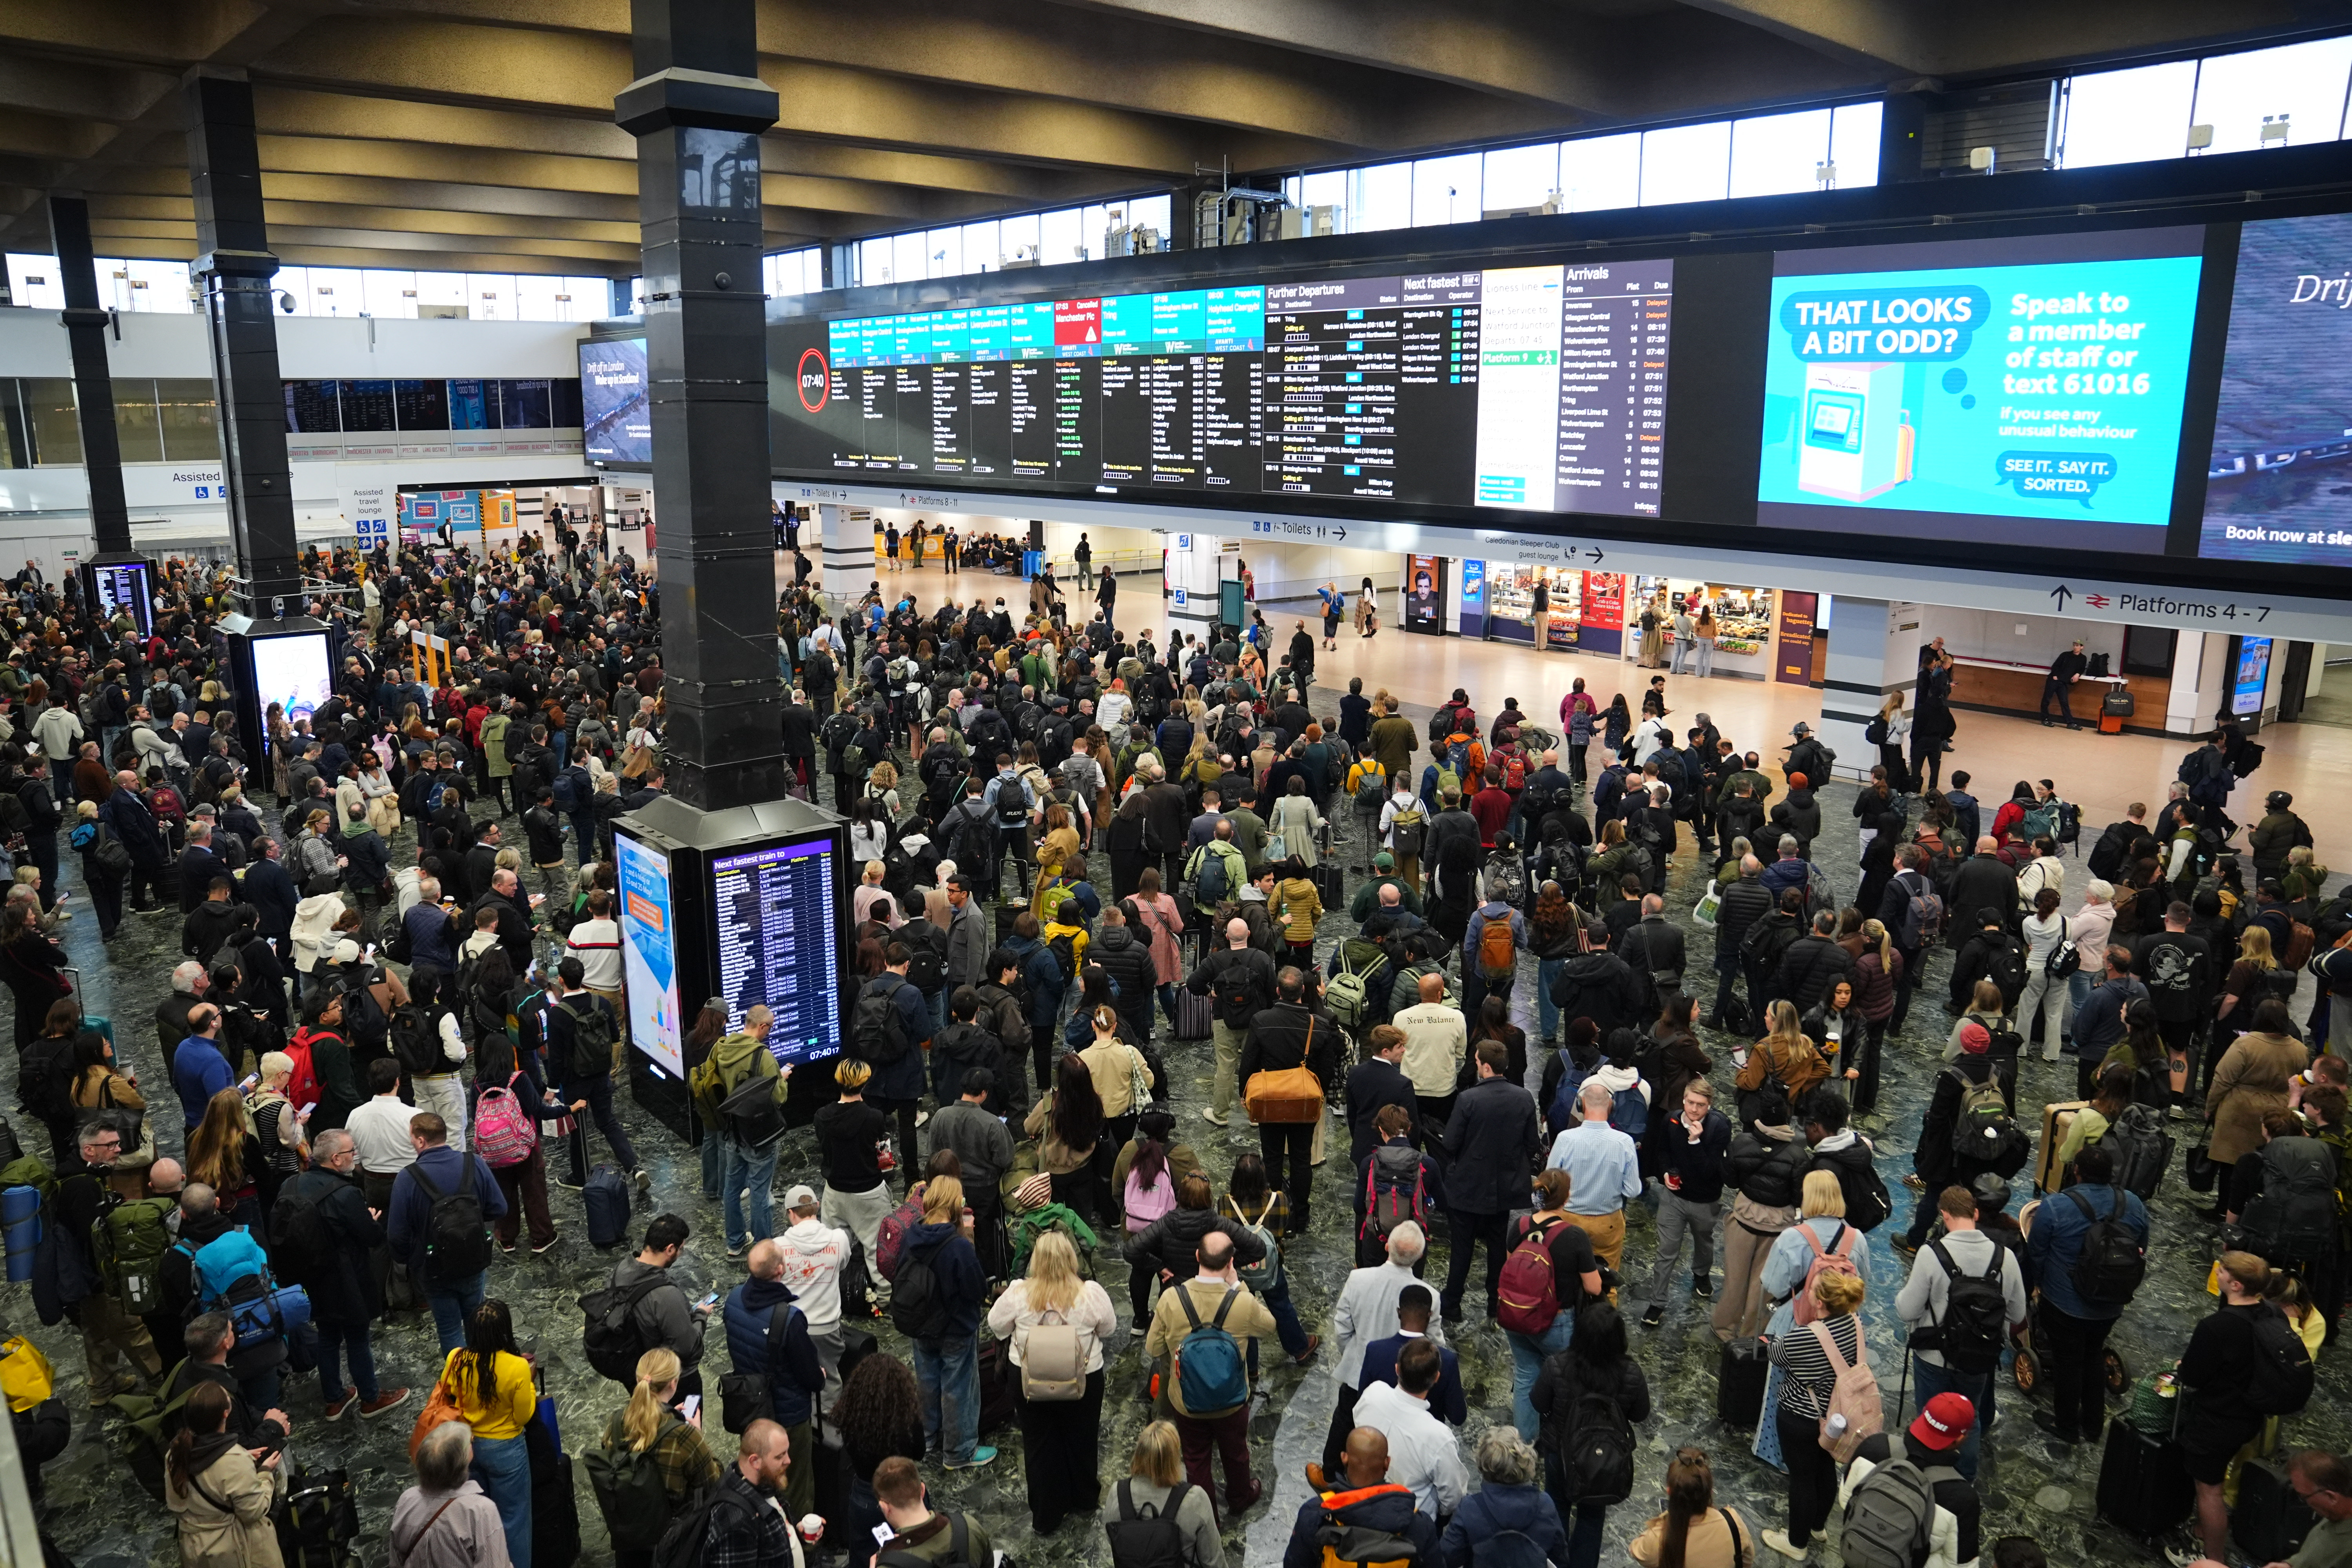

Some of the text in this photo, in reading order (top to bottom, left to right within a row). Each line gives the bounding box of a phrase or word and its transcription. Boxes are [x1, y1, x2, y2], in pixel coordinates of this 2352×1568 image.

[1567, 267, 1609, 281] Arrivals
[1404, 276, 1460, 290] Next fastest
[1487, 284, 1518, 293] Lioness
[1268, 285, 1344, 298] Further Departures
[1404, 293, 1434, 302] Destination
[1796, 297, 1972, 326] THAT LOOKS
[2011, 292, 2129, 318] Speak to
[1056, 313, 1085, 322] Manchester
[2008, 318, 2145, 342] a member
[1802, 328, 1958, 355] A BIT ODD?
[1483, 353, 1528, 363] Platform 9
[2006, 346, 2137, 370] of staff or
[587, 362, 597, 375] Drift
[603, 361, 607, 372] in
[608, 361, 624, 371] London
[595, 373, 639, 387] Wake up in Scotland
[802, 374, 824, 387] 07:40
[2004, 372, 2150, 395] text 61016
[2001, 406, 2100, 424] if you see any
[1999, 423, 2137, 439] unusual behaviour
[2005, 458, 2109, 476] SEE IT. SAY IT.
[173, 472, 220, 482] Assisted
[2024, 477, 2091, 494] SORTED.
[816, 489, 830, 498] Toilets
[918, 496, 944, 506] Platforms
[1634, 502, 1657, 510] infotec
[454, 508, 471, 518] London
[1283, 522, 1311, 535] Toilets
[2226, 526, 2266, 542] Book
[2269, 529, 2303, 543] now
[2308, 530, 2324, 543] at
[1485, 537, 1559, 548] Caledonian Sleeper Club
[1519, 551, 1559, 561] guest lounge
[2120, 595, 2217, 619] Platforms
[2223, 604, 2237, 619] 4
[2258, 607, 2271, 622] 7
[1780, 632, 1812, 641] Breadicated,
[715, 860, 732, 869] Next
[733, 855, 758, 866] fastest
[759, 853, 776, 862] train
[810, 1048, 832, 1060] 07:40
[1924, 1410, 1948, 1432] MIAMI
